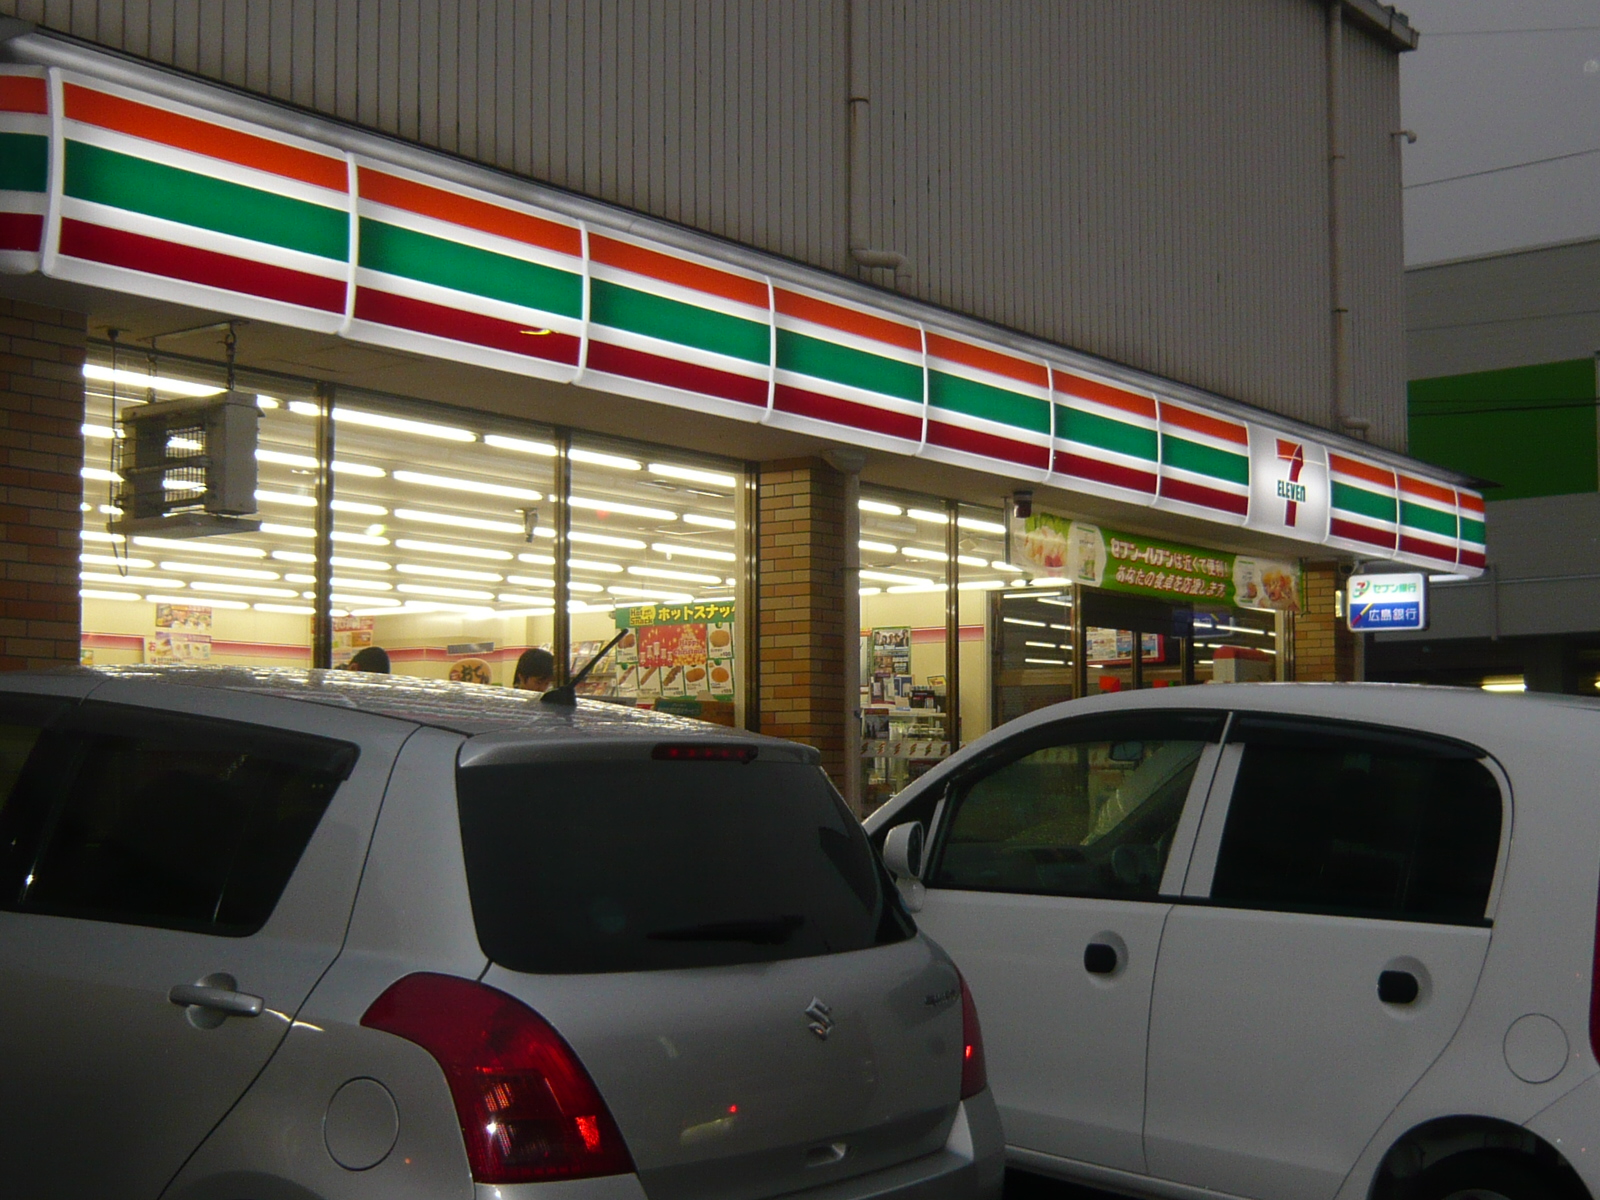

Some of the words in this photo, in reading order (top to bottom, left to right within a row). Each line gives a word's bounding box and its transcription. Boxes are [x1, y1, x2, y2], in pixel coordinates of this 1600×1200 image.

[1276, 438, 1304, 527] 7
[1368, 608, 1417, 621] 広島銀行
